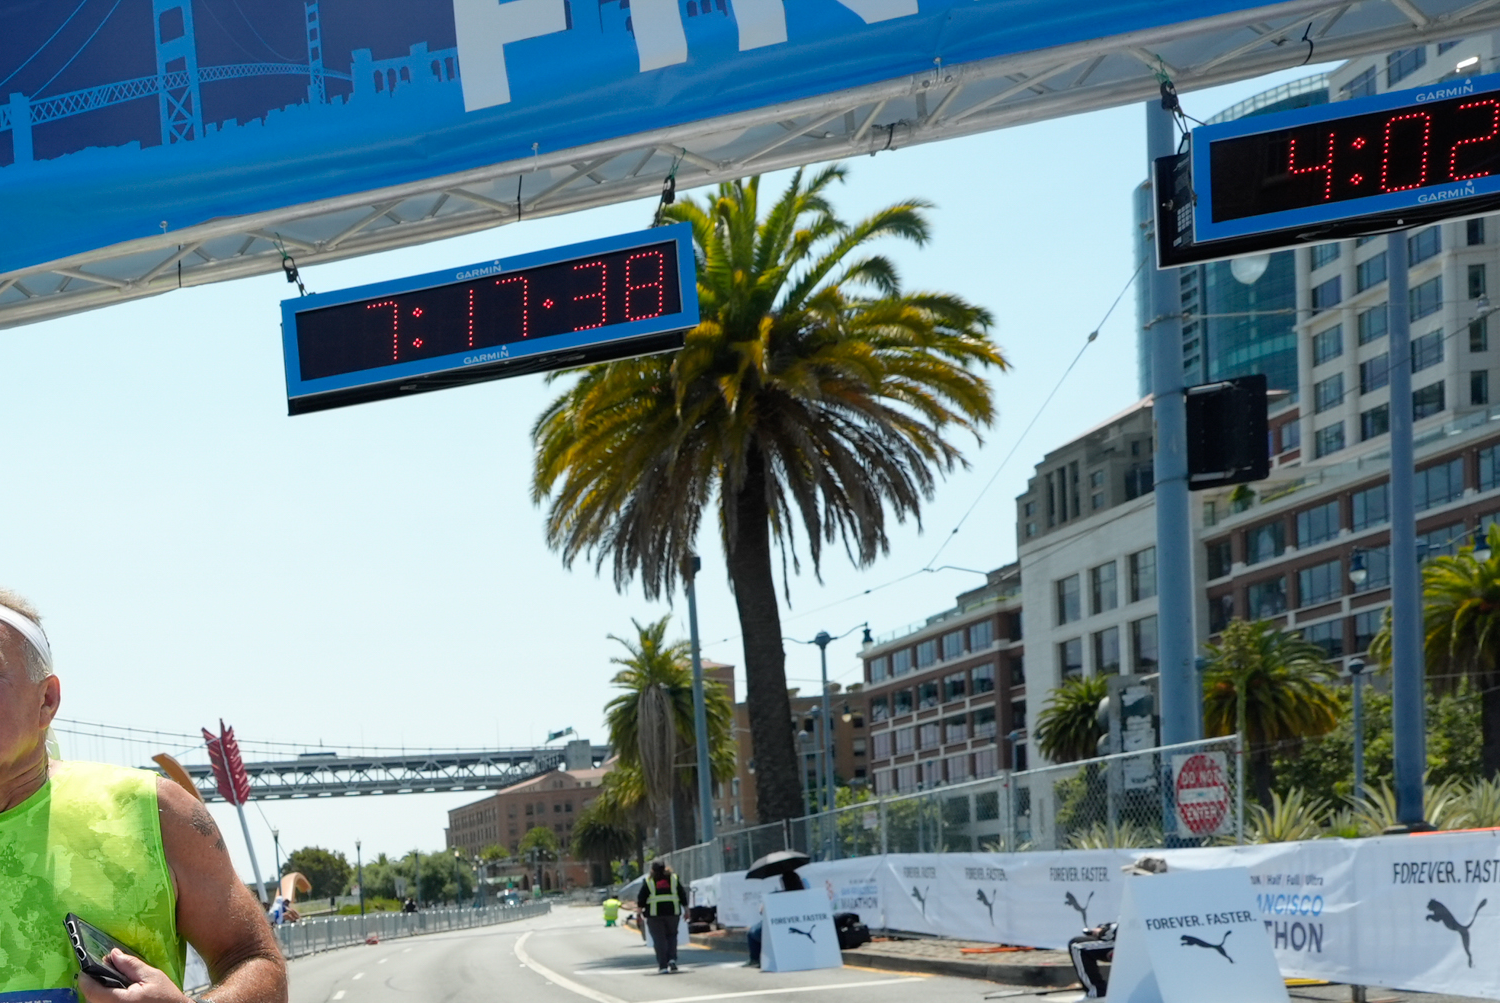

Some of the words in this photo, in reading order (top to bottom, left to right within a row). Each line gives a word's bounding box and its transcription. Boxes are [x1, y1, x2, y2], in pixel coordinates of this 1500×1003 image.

[1415, 84, 1474, 102] GARMIN
[1418, 185, 1475, 203] GARMIN
[455, 262, 502, 280] GARMIN
[463, 347, 509, 365] GARMIN
[1181, 771, 1196, 785] DO
[1200, 769, 1221, 783] NOT
[1187, 806, 1218, 821] ENTER
[1050, 867, 1080, 881] FOREVER.
[1081, 867, 1110, 881] FASTER.
[1392, 861, 1461, 884] FOREVER.
[1465, 859, 1500, 883] FAST
[1146, 915, 1204, 931] FOREVER.
[1207, 910, 1257, 926] FASTER.
